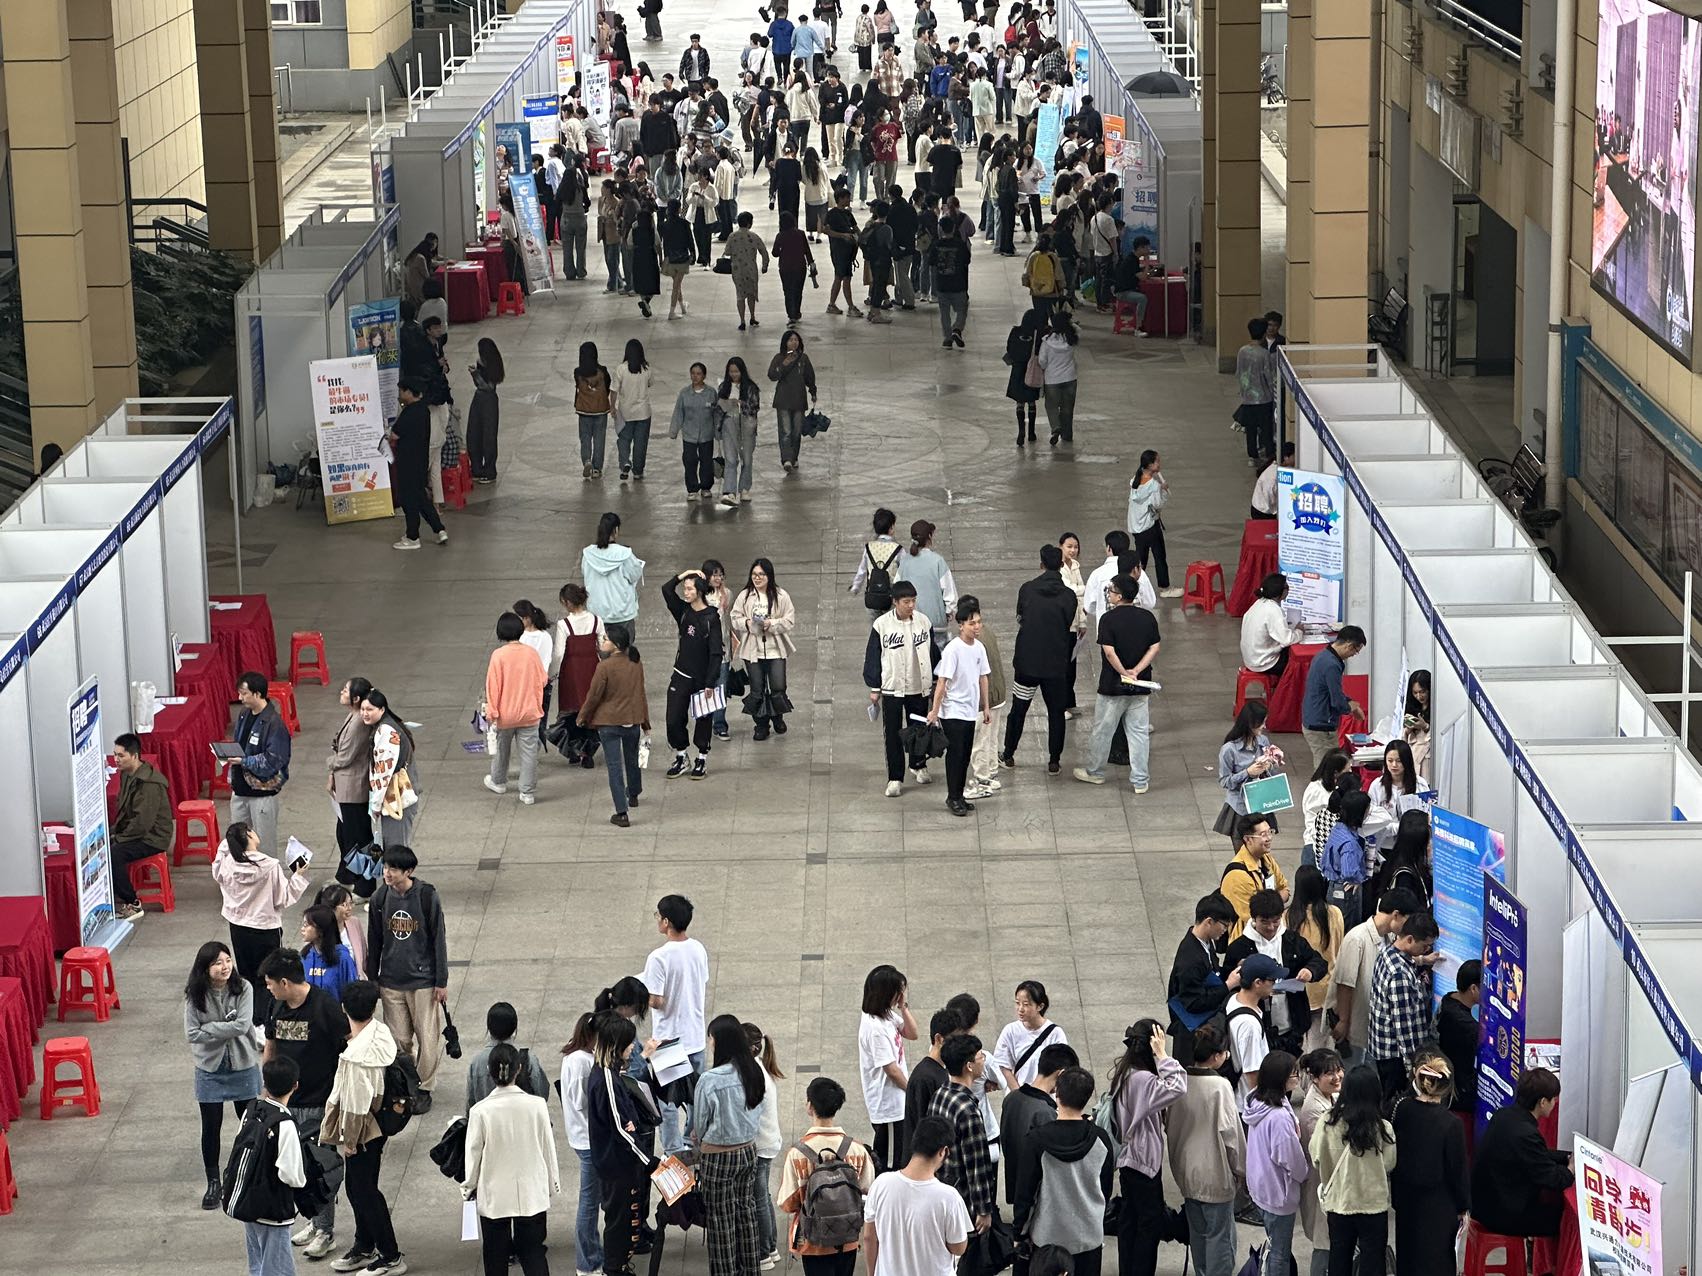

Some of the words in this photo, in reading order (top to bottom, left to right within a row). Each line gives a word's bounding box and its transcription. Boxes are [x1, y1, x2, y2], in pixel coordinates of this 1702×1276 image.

[1298, 492, 1330, 515] 招聘
[1489, 888, 1519, 929] IntelliPro
[1583, 1163, 1623, 1205] 同学
